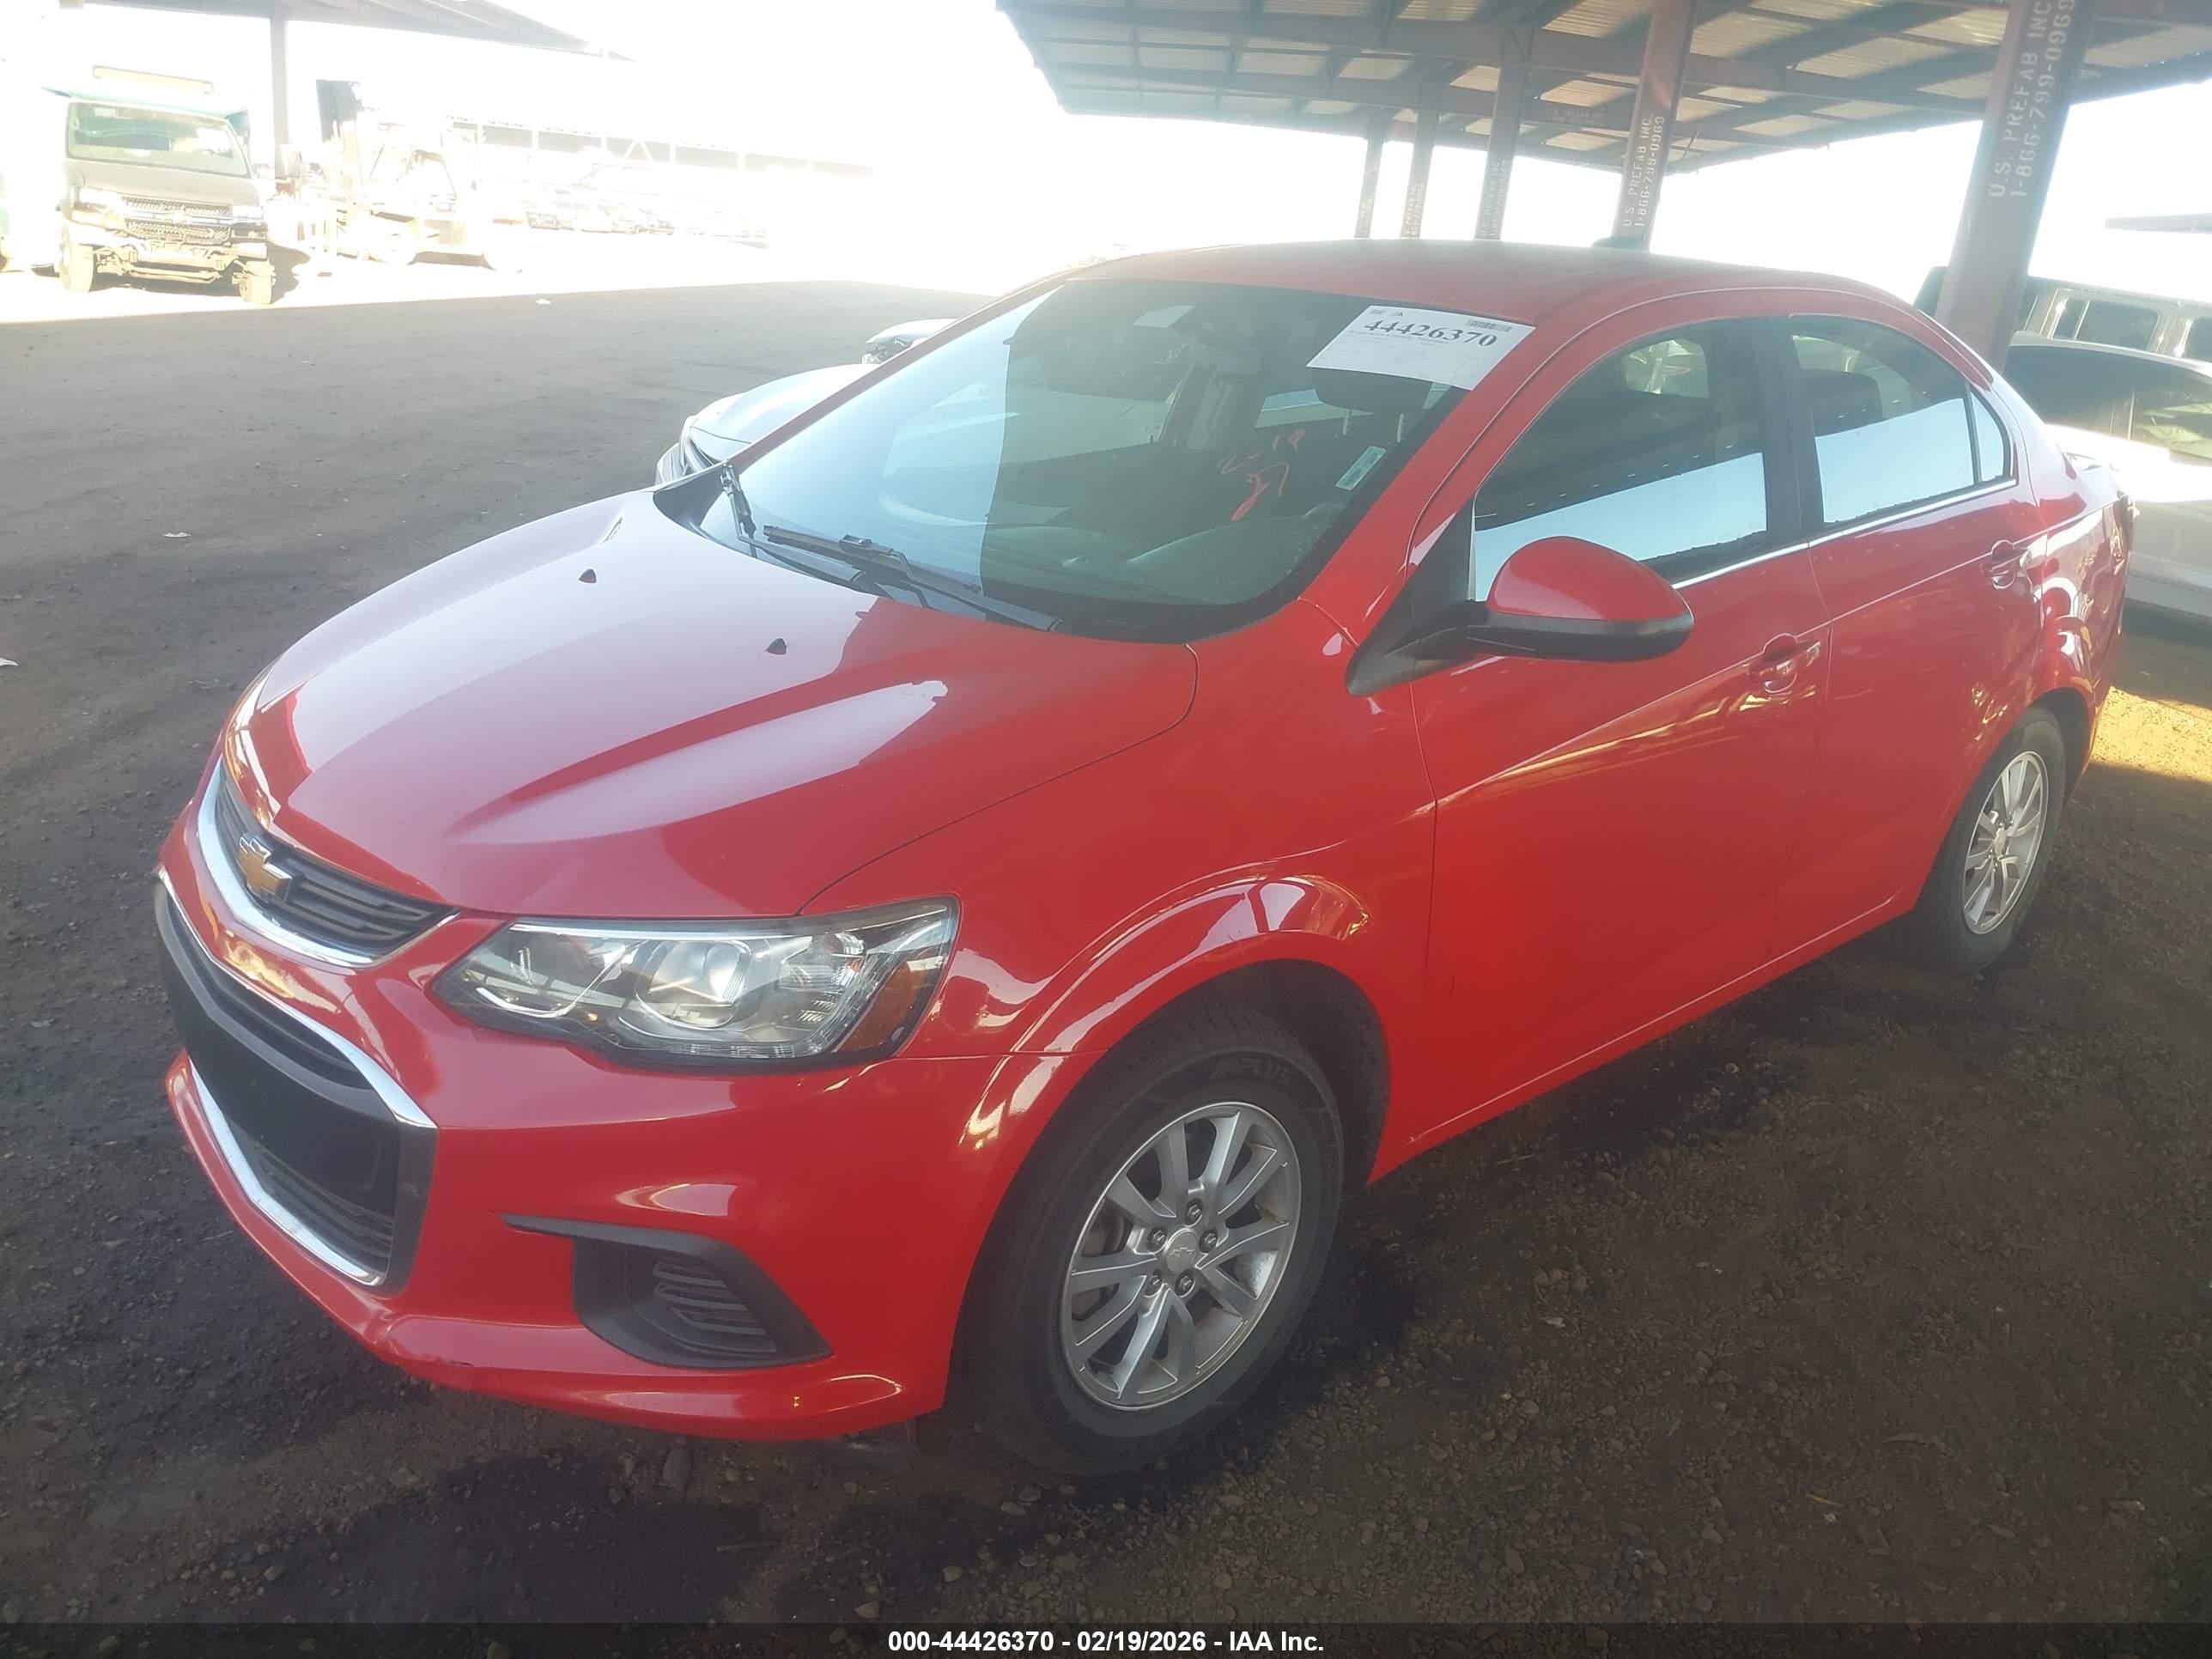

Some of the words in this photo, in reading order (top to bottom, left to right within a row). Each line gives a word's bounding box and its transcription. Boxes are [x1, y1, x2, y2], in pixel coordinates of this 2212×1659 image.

[2002, 52, 2038, 142] PREFAB
[1628, 146, 1646, 196] PREFAB
[1364, 319, 1498, 346] 44426370
